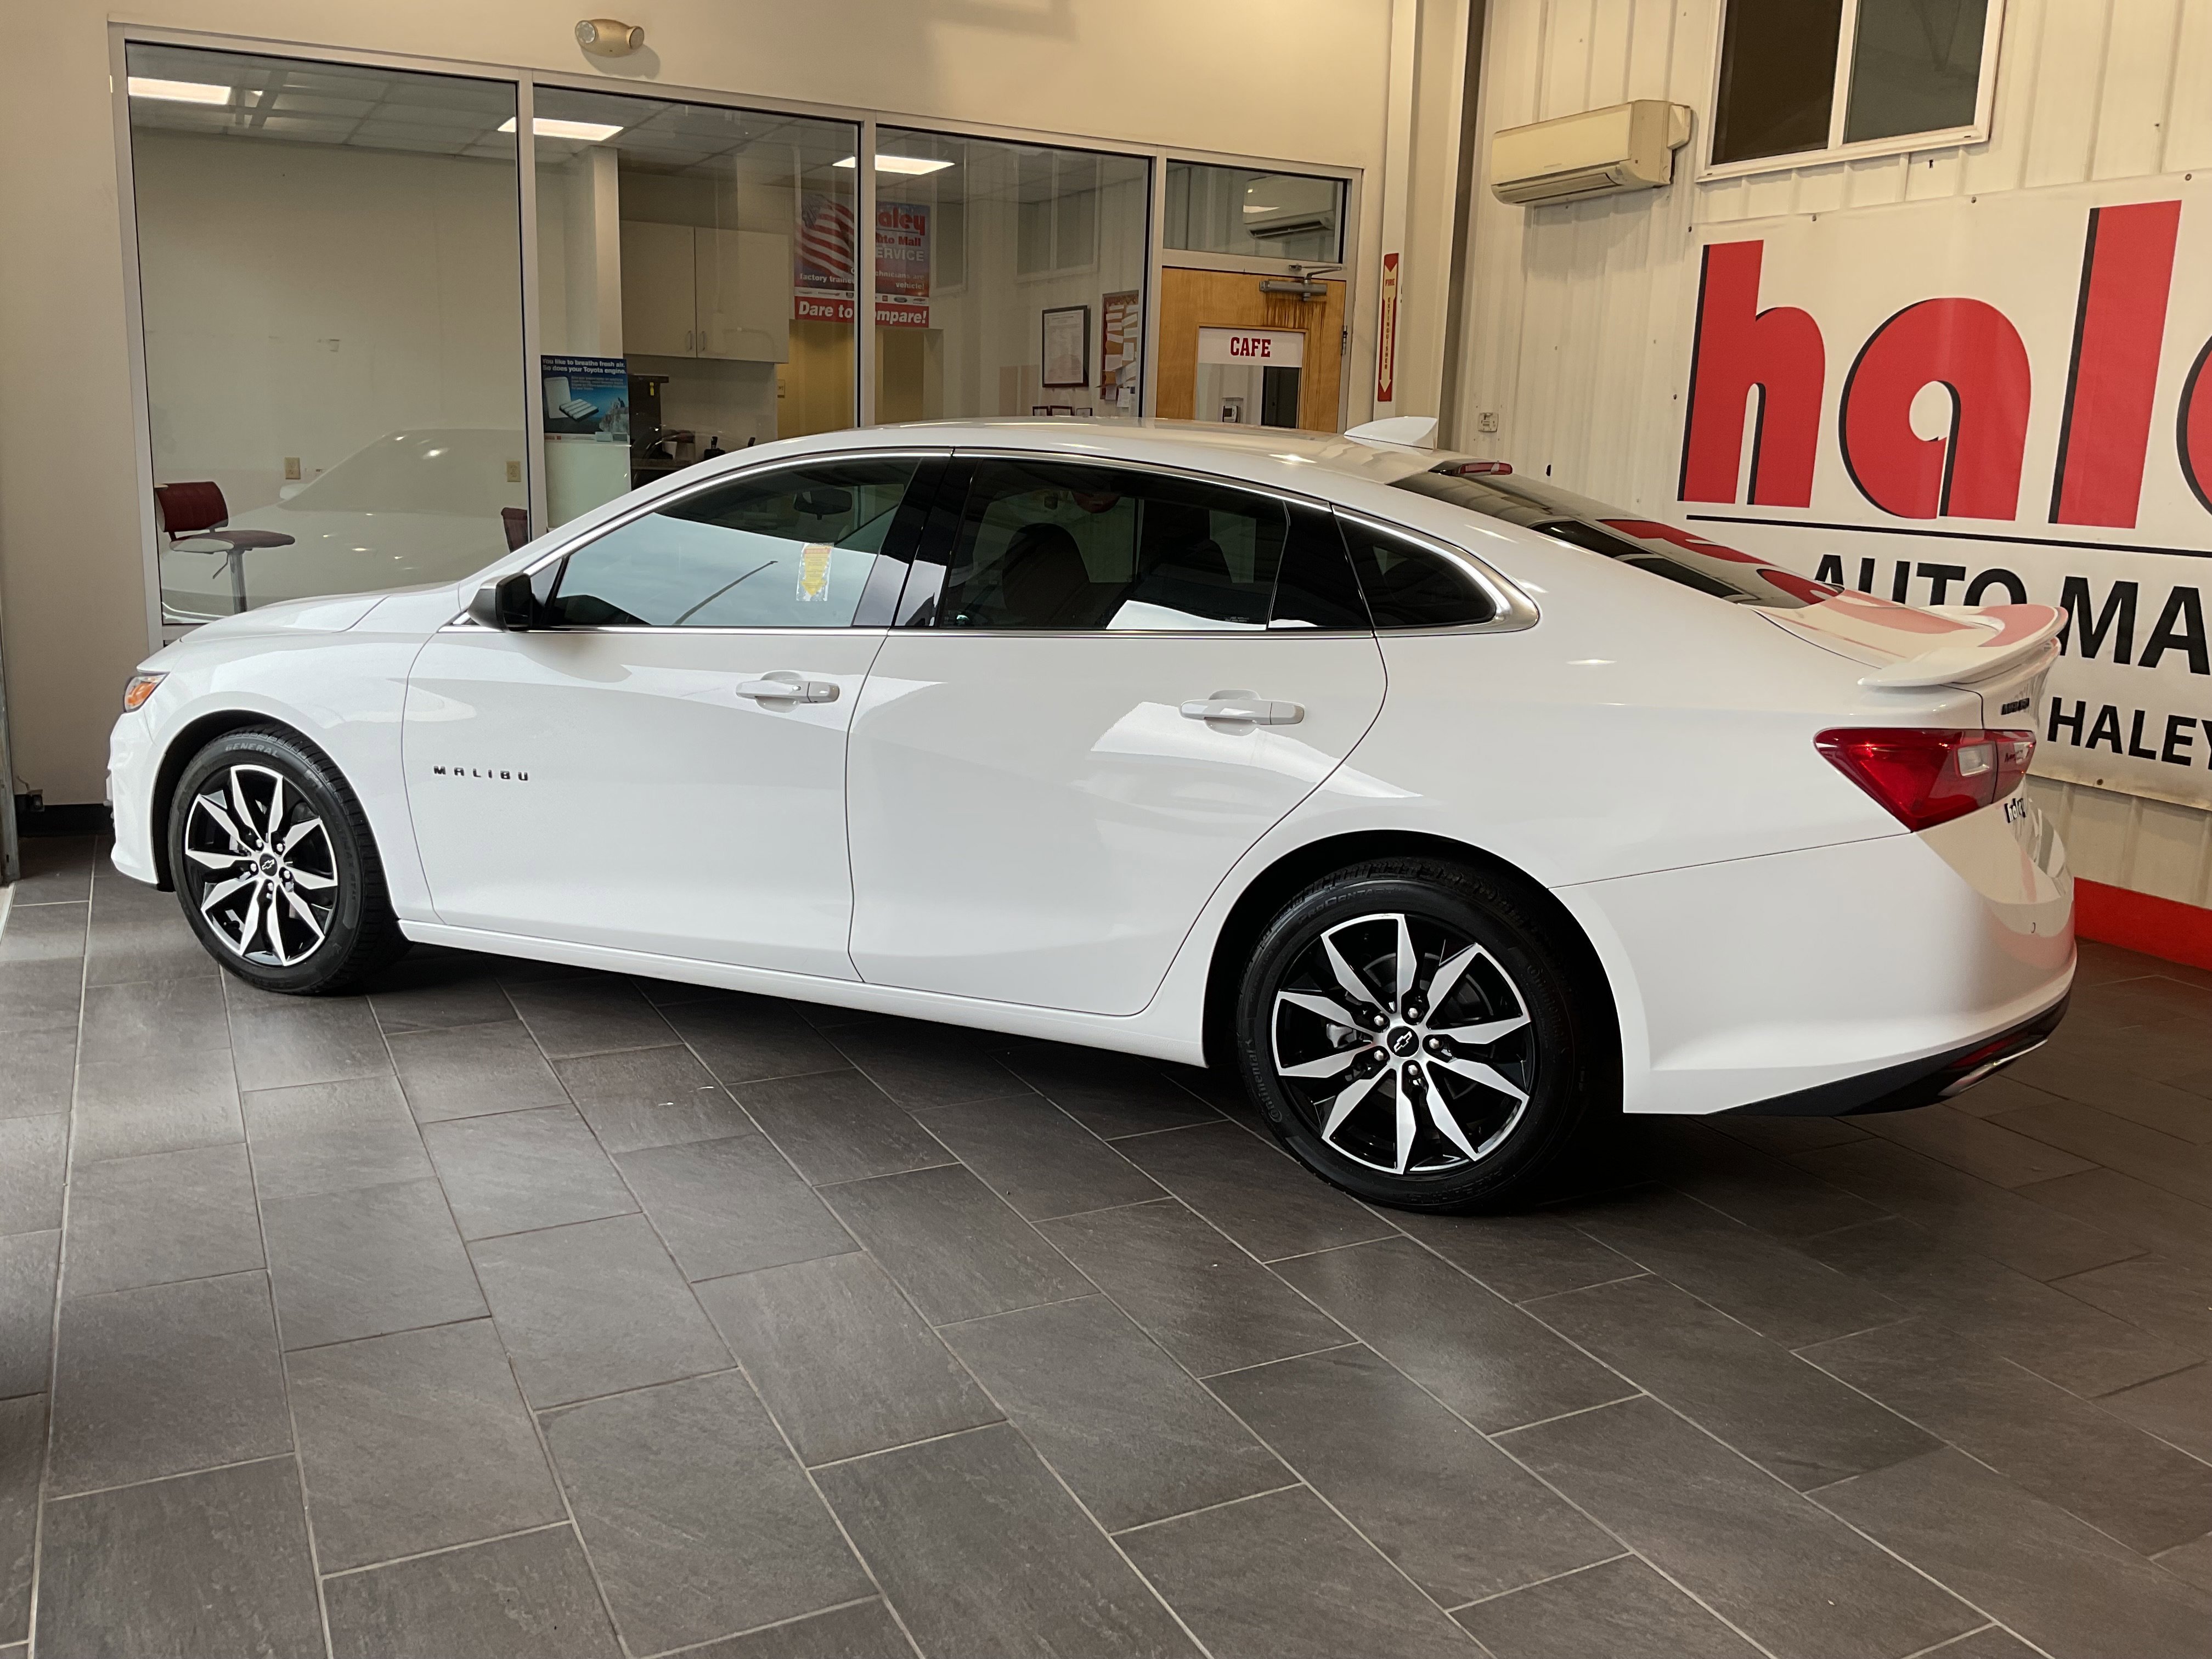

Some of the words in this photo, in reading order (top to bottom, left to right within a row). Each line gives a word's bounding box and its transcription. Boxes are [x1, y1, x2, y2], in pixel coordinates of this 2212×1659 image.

[878, 206, 926, 236] aley
[876, 232, 895, 244] uto
[898, 236, 921, 246] Mall
[876, 246, 924, 262] ERVICE
[800, 273, 827, 283] factory
[876, 270, 910, 279] chnicians
[1385, 278, 1395, 286] FIRE
[799, 301, 834, 317] Dare
[838, 304, 853, 318] to
[876, 311, 927, 324] mpare!
[1231, 337, 1271, 358] CAFE
[1677, 200, 2212, 529] hal
[2047, 696, 2212, 770] HALE
[433, 765, 528, 781] MALIBU
